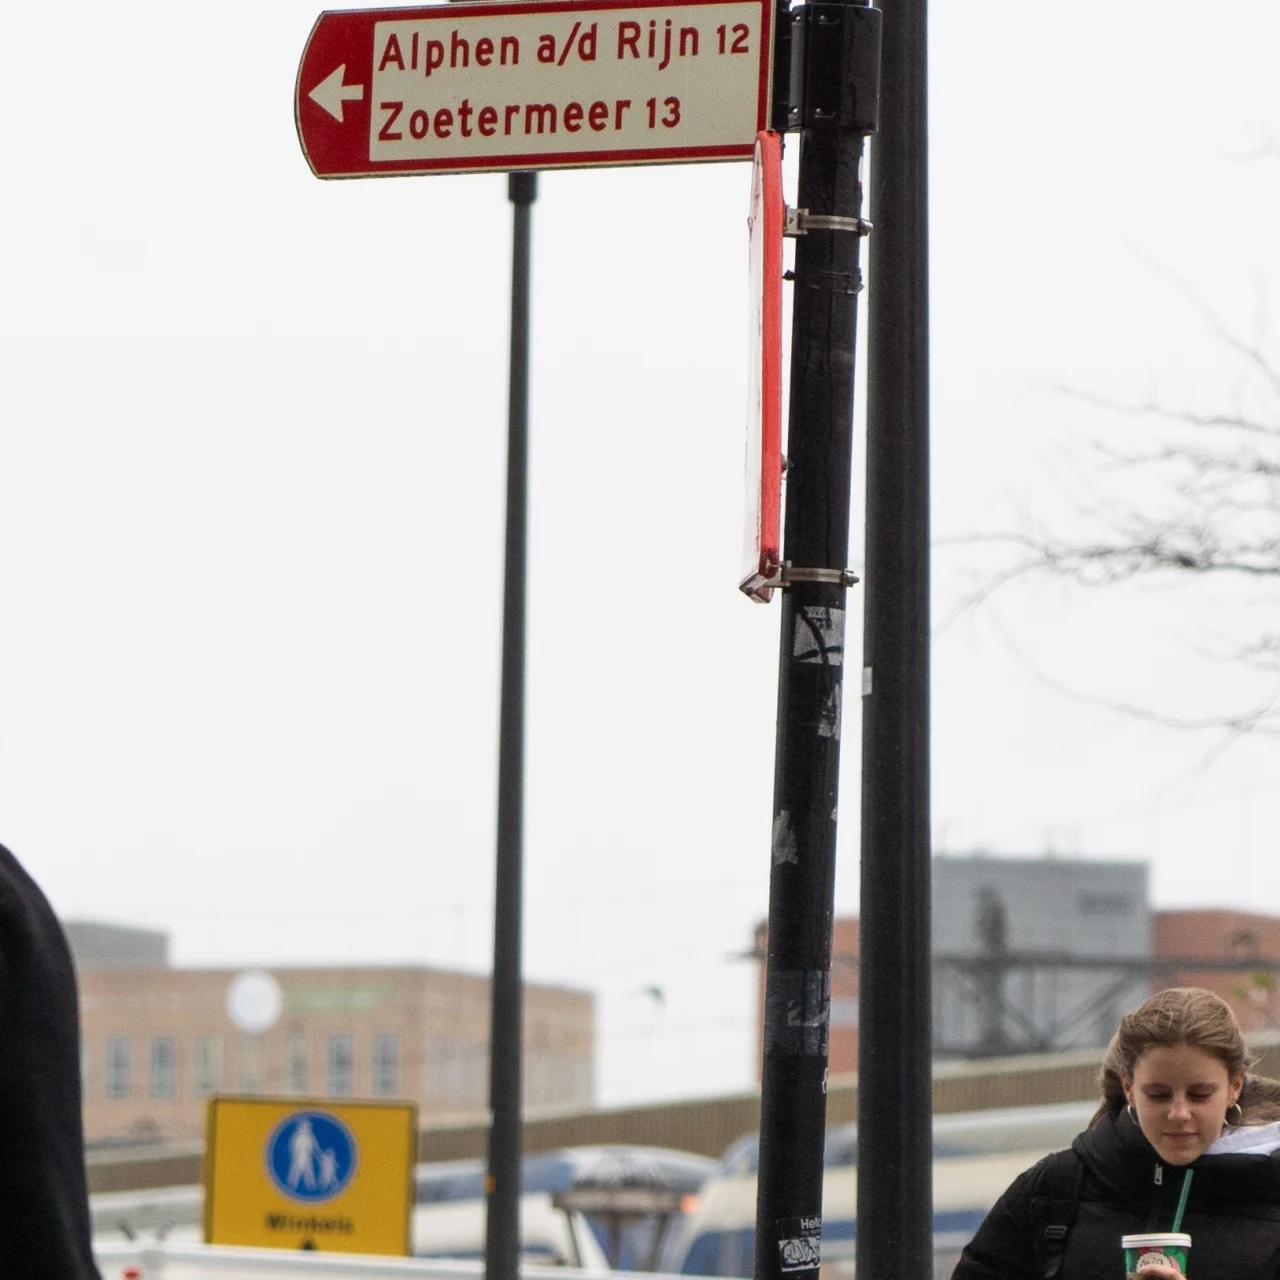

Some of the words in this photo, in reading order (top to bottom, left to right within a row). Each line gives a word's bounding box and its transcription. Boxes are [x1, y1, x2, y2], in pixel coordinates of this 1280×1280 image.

[378, 29, 520, 78] Alphen
[537, 21, 598, 67] a/d
[617, 18, 700, 71] Rijn
[716, 23, 751, 55] 12
[378, 98, 632, 142] Zoetermeer
[646, 96, 682, 129] 13
